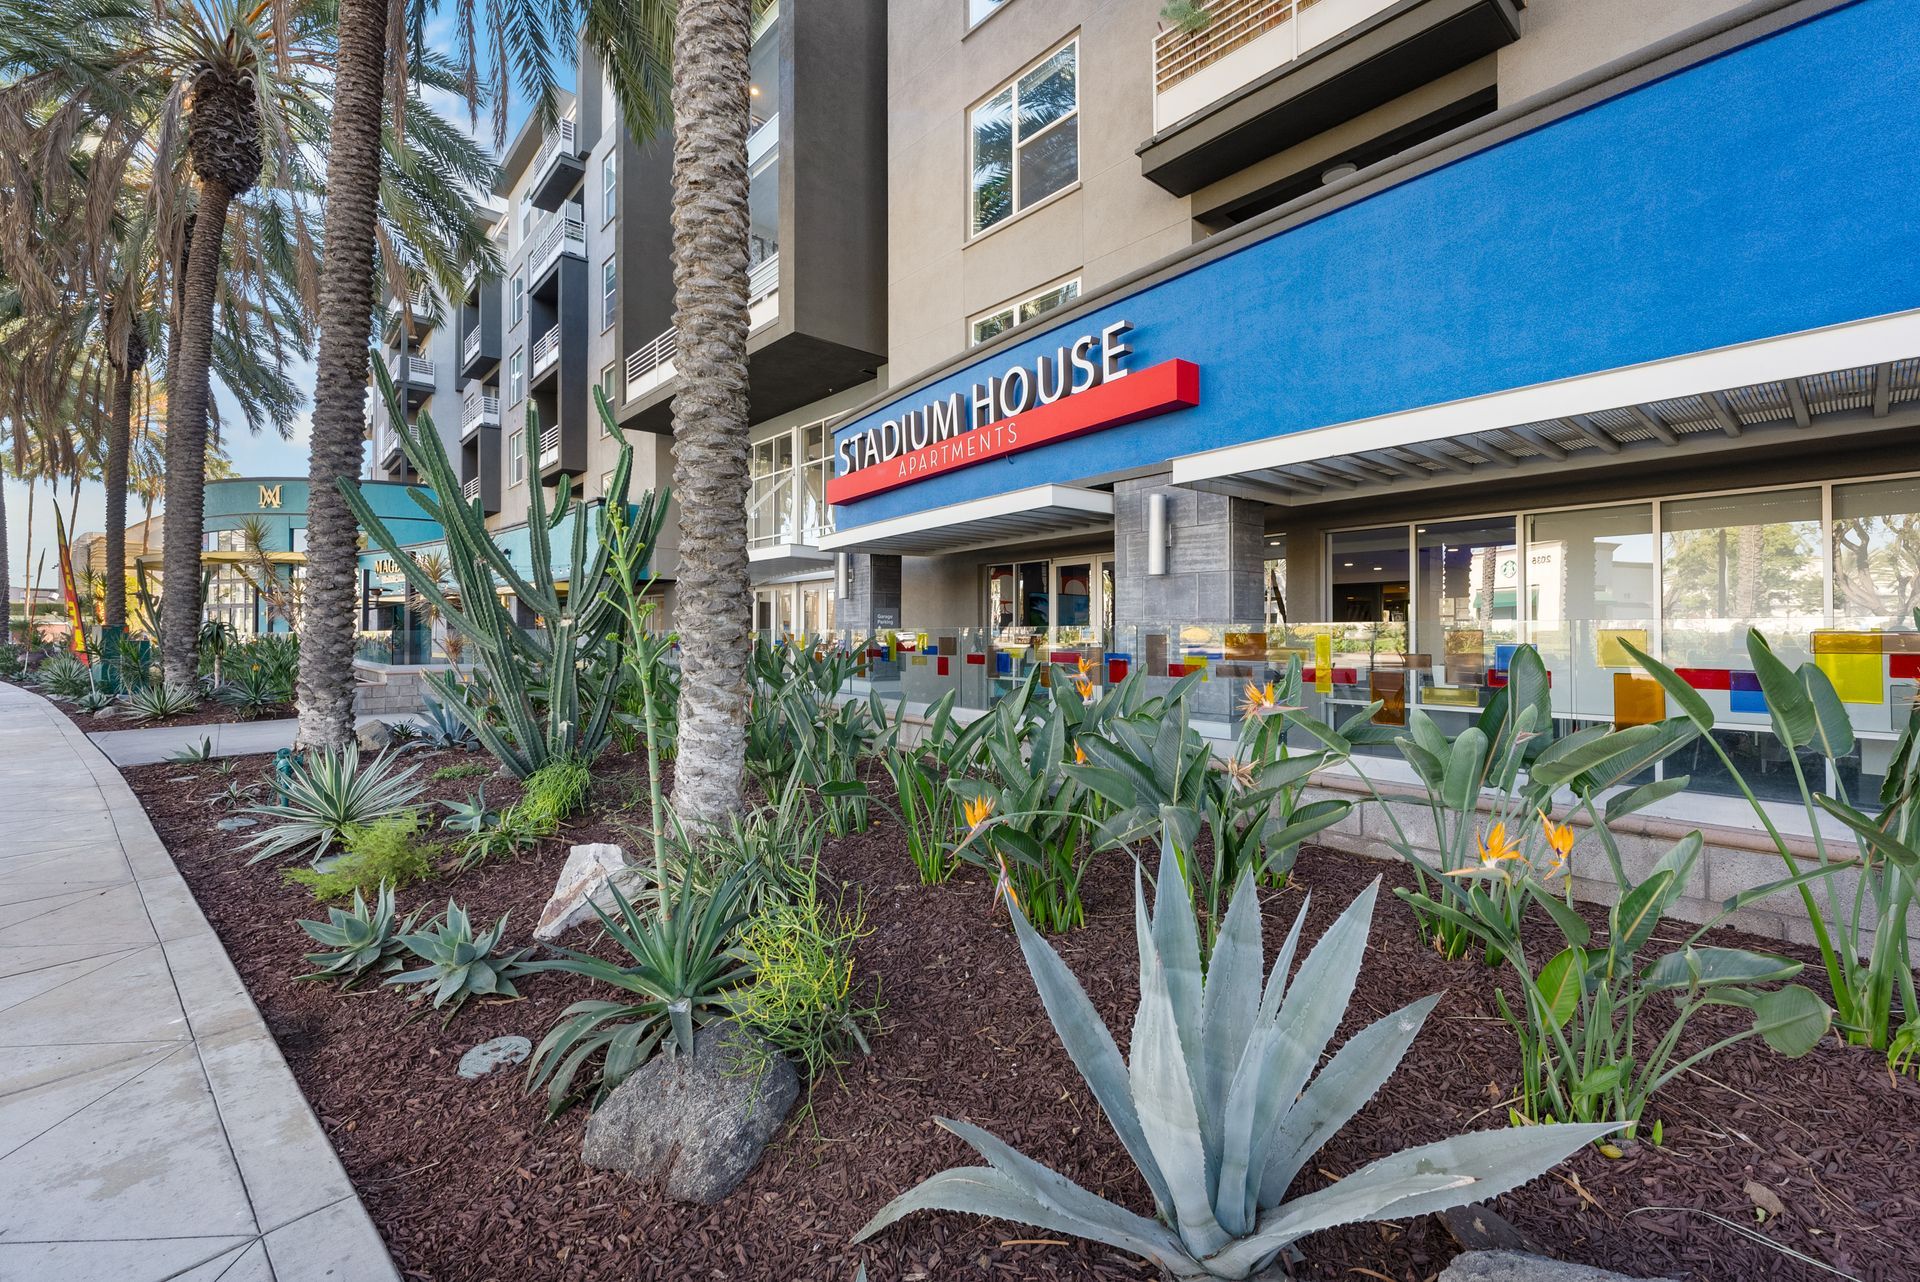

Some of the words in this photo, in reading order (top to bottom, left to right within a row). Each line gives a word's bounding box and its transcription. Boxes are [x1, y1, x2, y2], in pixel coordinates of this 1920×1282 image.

[839, 392, 963, 477] STADIUM
[972, 320, 1132, 430] HOUSE
[898, 422, 1018, 478] APARTMENTS
